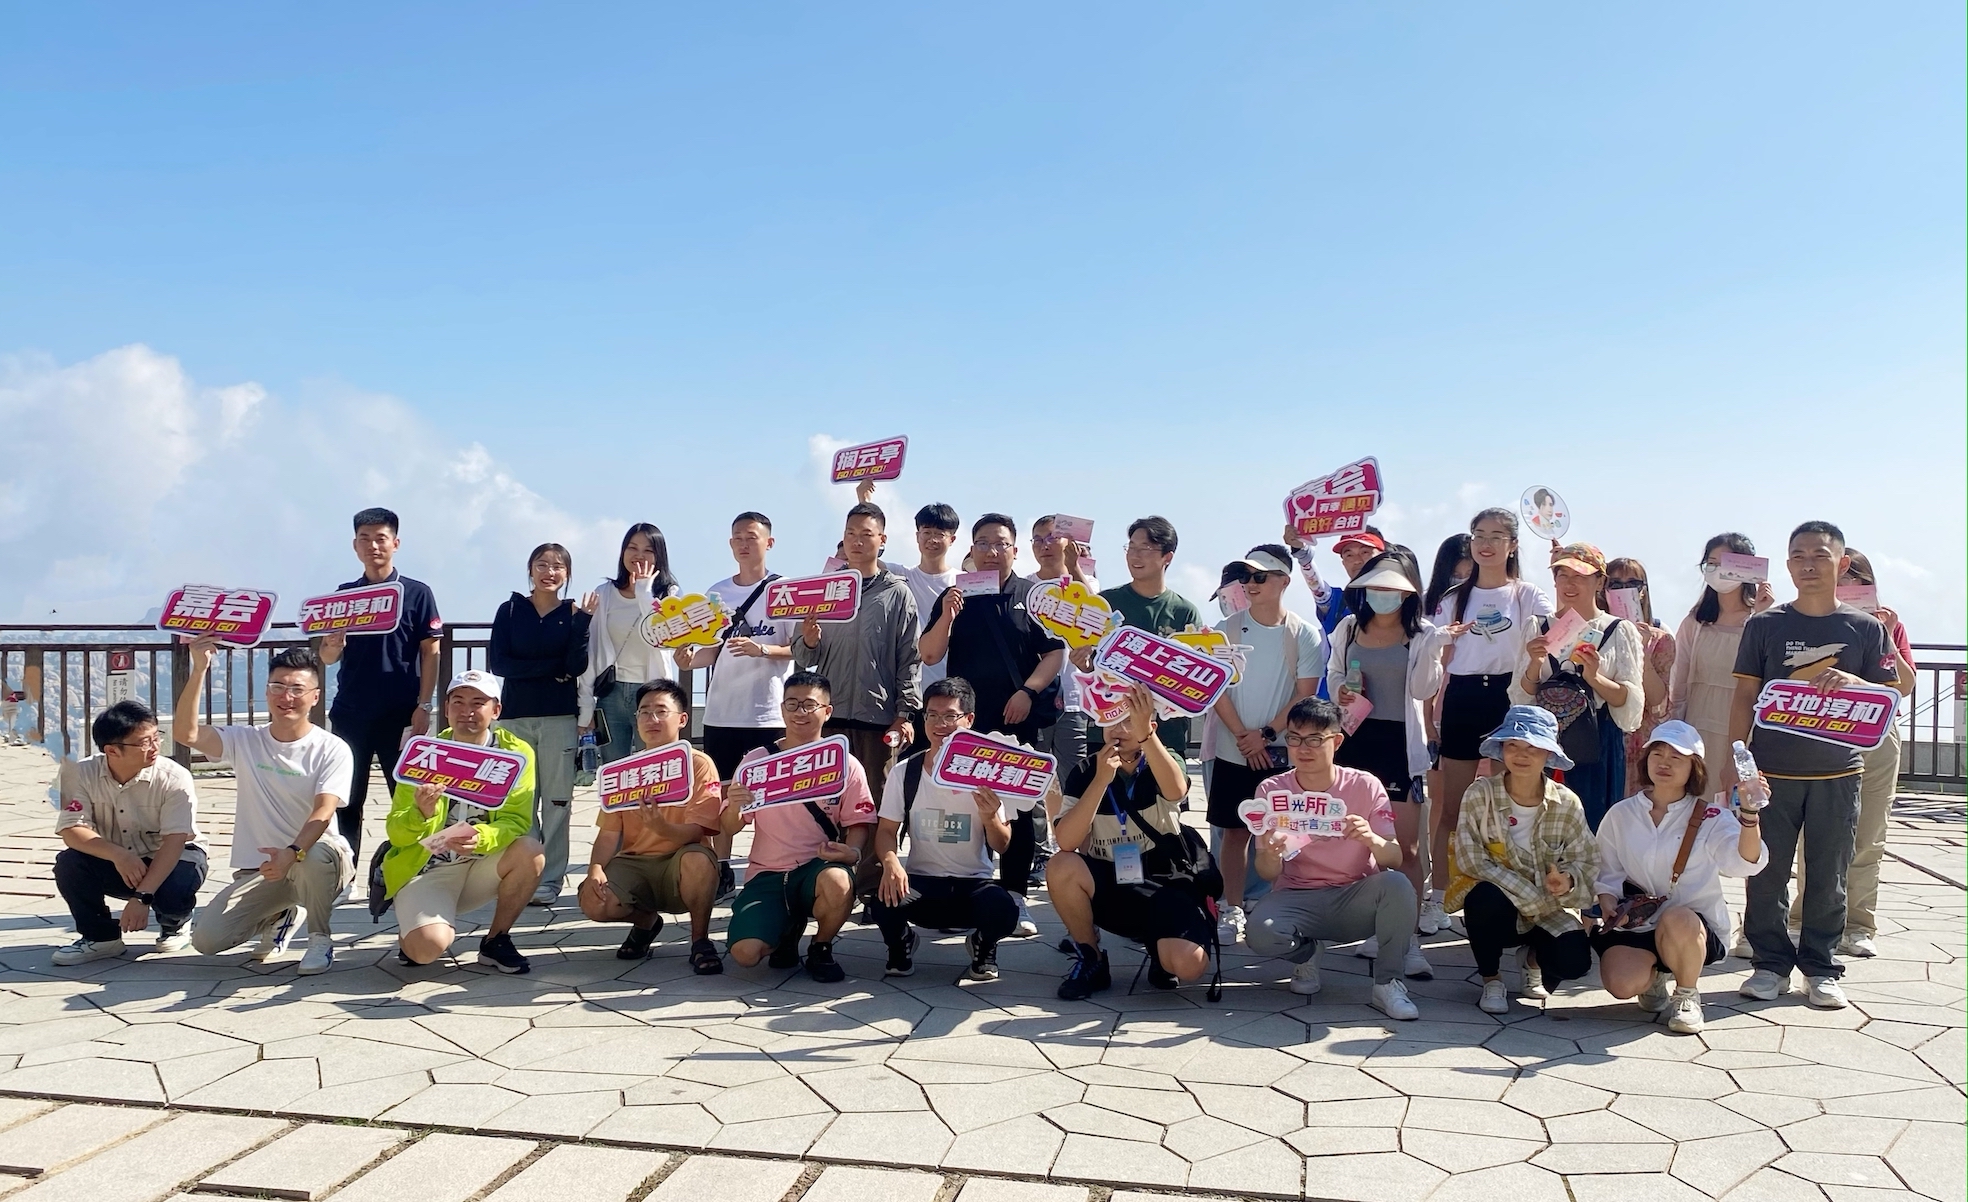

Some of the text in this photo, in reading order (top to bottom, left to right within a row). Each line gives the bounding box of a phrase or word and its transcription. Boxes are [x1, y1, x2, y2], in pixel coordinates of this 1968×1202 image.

[836, 465, 886, 479] GO! GO! GO!
[171, 585, 262, 622] 嘉会
[770, 580, 852, 607] 太一峰
[299, 595, 394, 622] 天地淳和
[772, 603, 836, 617] GO! GO! GO!
[1030, 593, 1110, 640] 摘星亭
[165, 617, 241, 632] GO! GO! GO!
[308, 615, 377, 631] GO! GO! GO!
[645, 600, 717, 647] 摘星亭
[1101, 651, 1153, 678] 第一
[1118, 632, 1219, 688] 海上名山
[1155, 674, 1209, 702] GO! GO!
[1759, 689, 1885, 724] 天地淳和
[1766, 712, 1856, 733] GO! GO! GO!
[405, 744, 516, 785] 太一峰
[601, 757, 683, 796] 巨峰索道
[746, 749, 837, 786] 海上名山
[403, 767, 487, 793] GO! GO! GO!
[792, 771, 841, 792] GO! GO!
[1272, 795, 1341, 815] 目光所及
